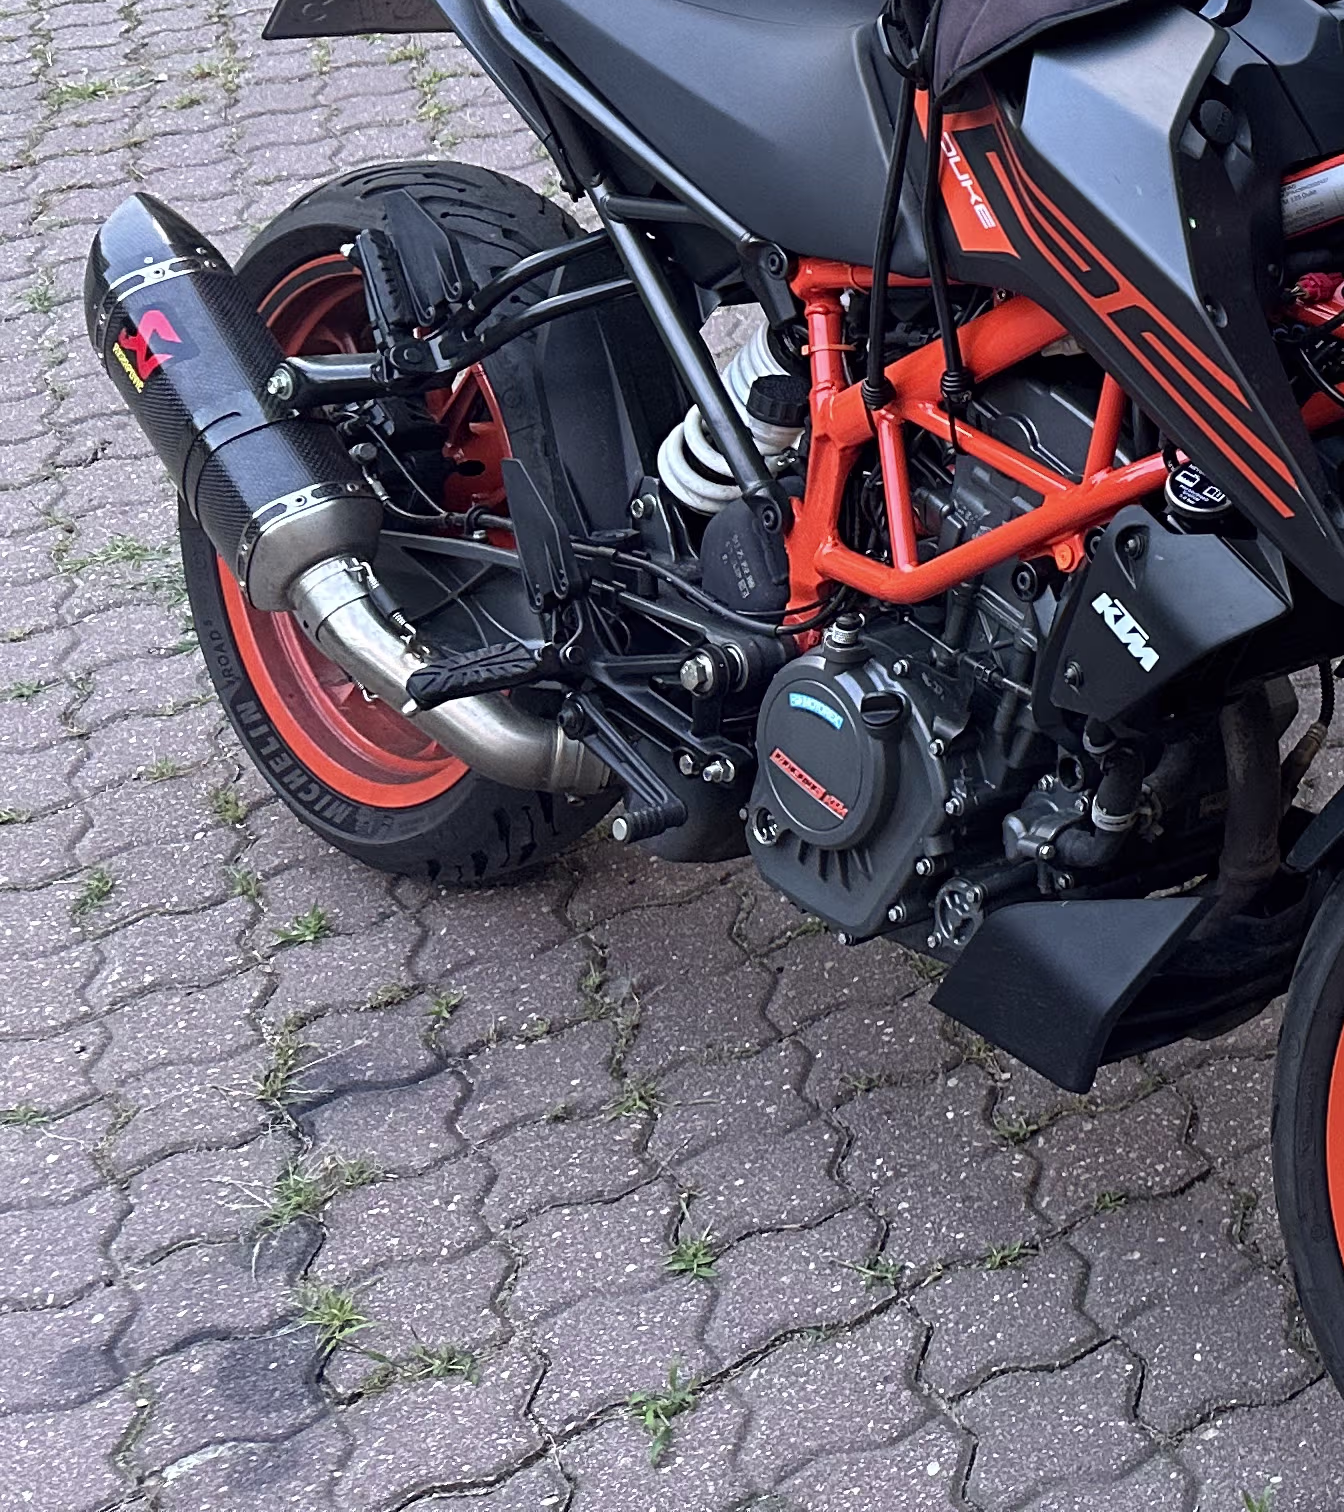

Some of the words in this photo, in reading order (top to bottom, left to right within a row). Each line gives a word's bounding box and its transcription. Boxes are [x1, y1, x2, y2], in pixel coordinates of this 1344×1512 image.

[940, 131, 997, 230] DUKE
[1091, 592, 1160, 673] KTM
[236, 700, 351, 829] MICHELIN
